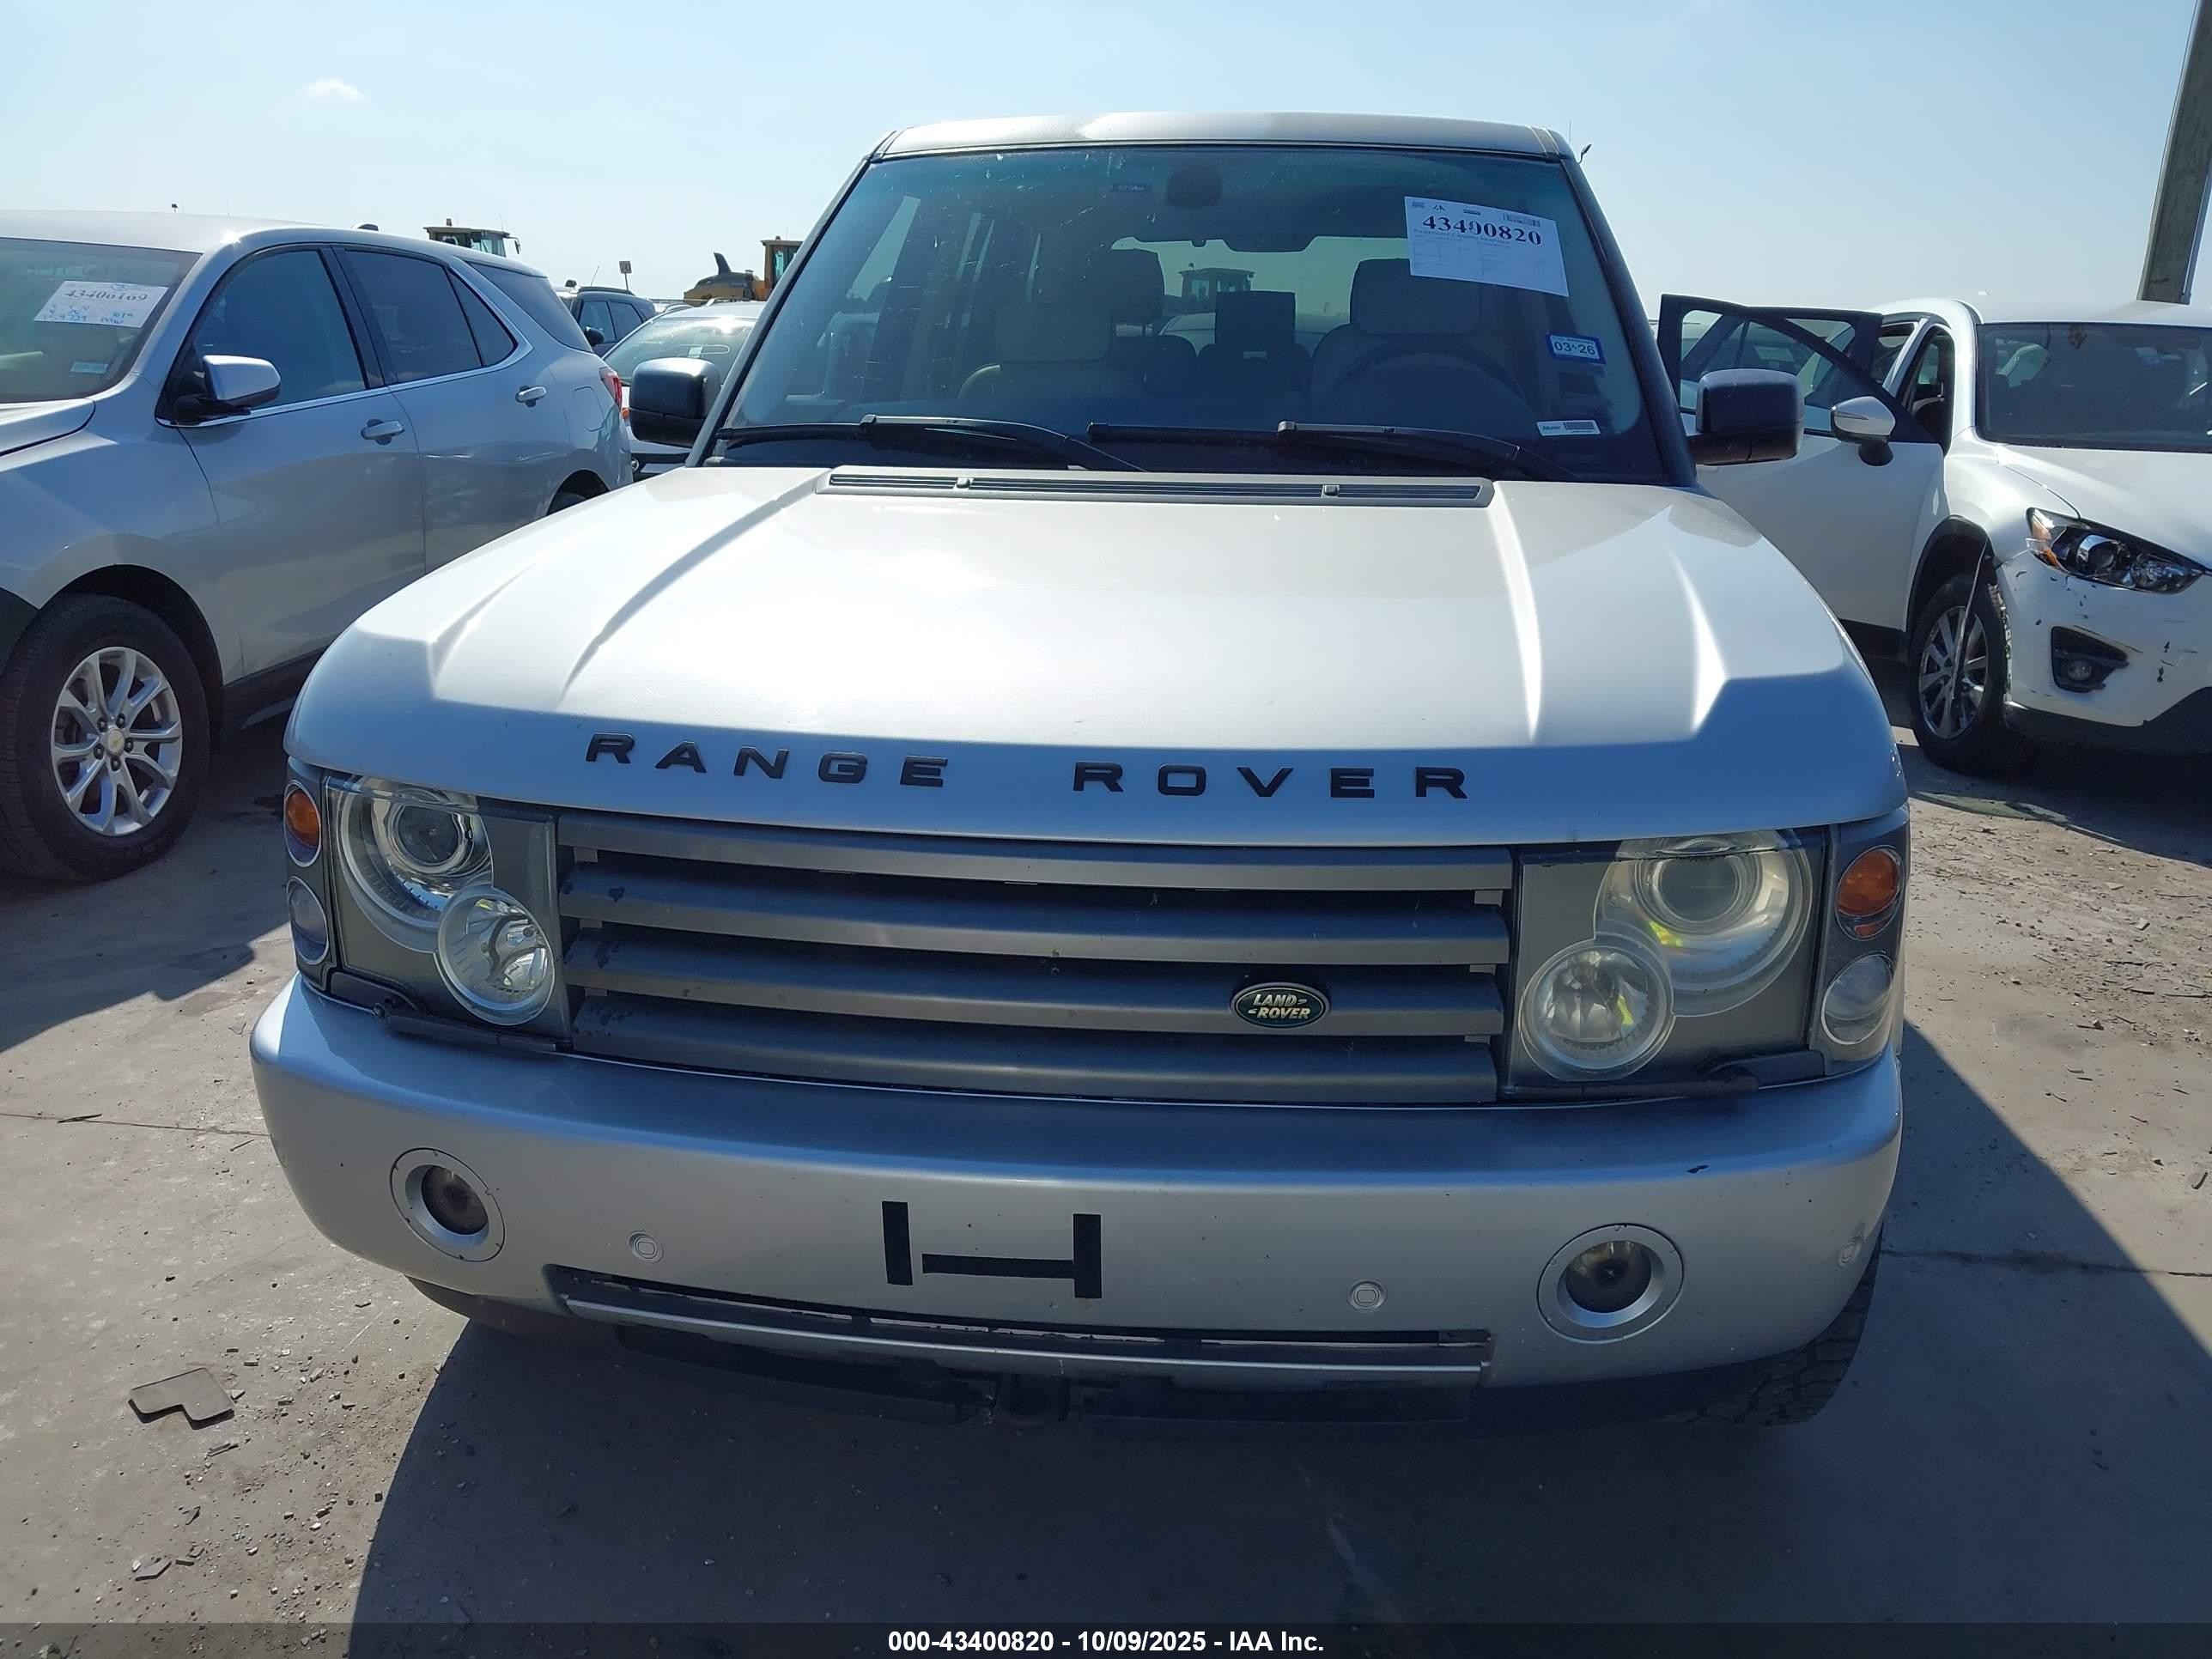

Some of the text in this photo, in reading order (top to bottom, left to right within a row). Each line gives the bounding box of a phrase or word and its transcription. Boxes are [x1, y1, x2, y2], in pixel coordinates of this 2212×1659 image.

[585, 732, 1468, 799] RANGE ROVER
[1253, 994, 1298, 1007] LAND
[1256, 1006, 1311, 1019] ROVER
